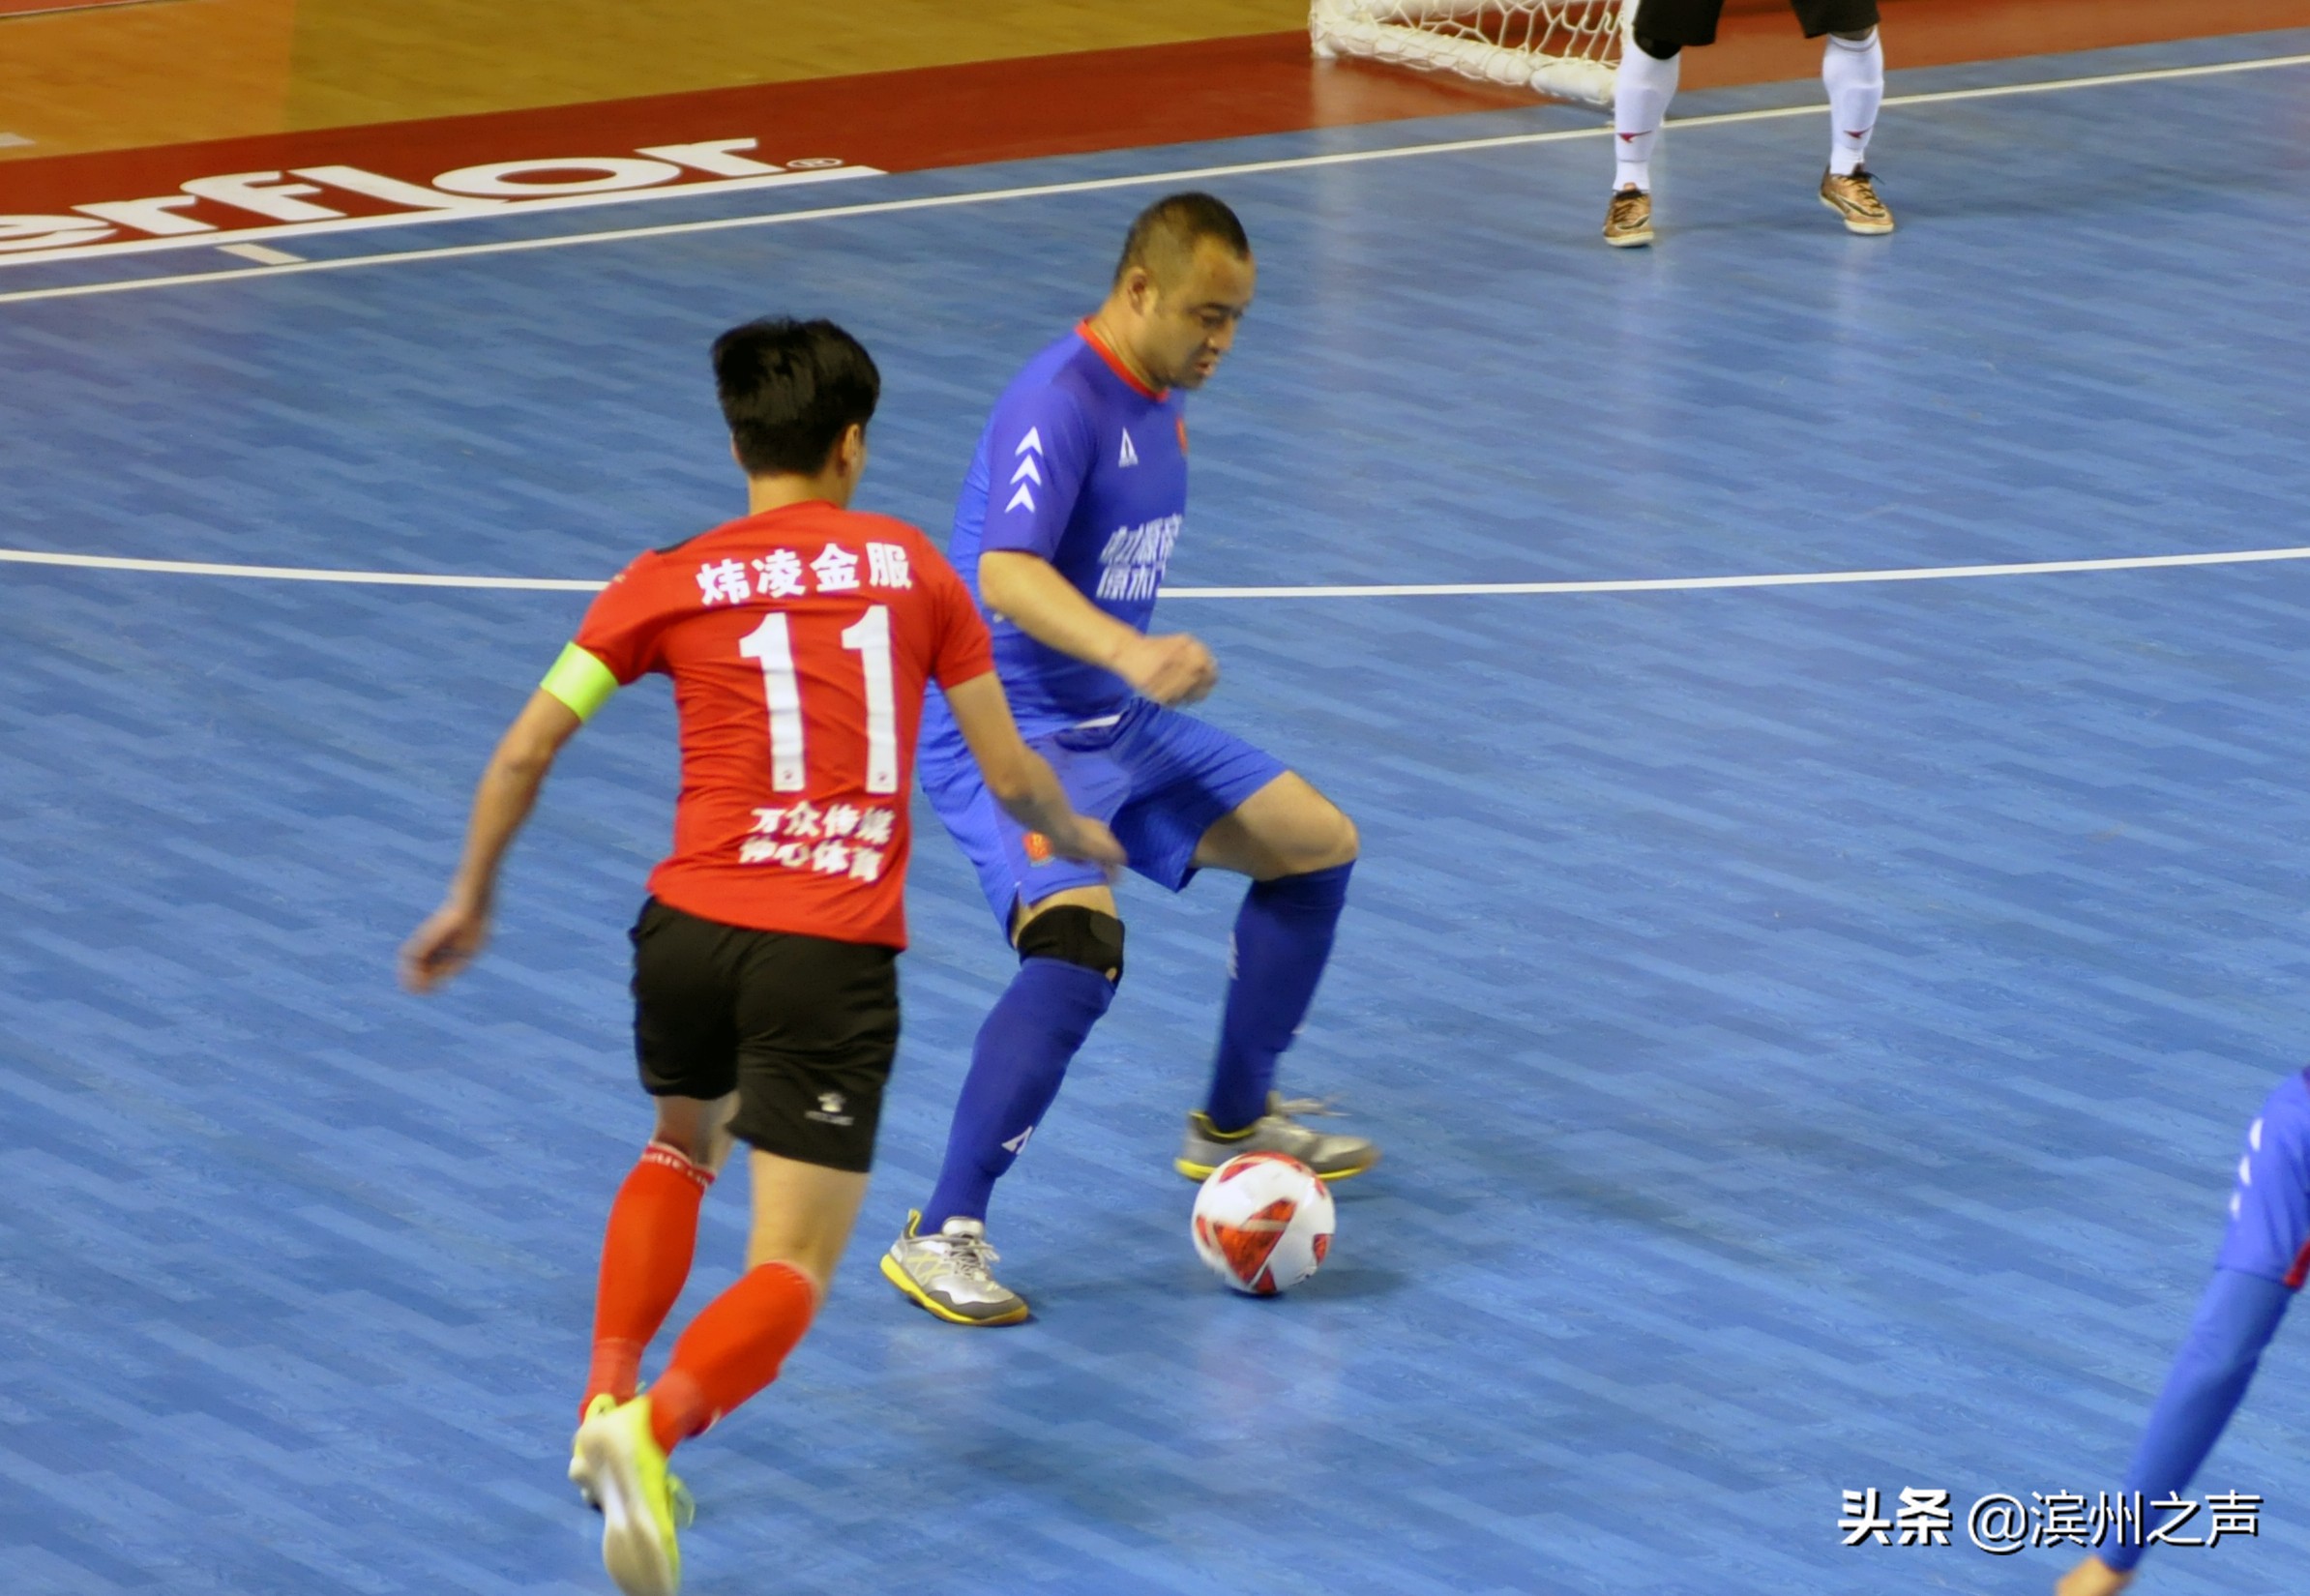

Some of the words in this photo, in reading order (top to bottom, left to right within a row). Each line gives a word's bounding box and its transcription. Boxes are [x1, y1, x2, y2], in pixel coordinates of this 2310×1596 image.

[695, 542, 913, 606] 炜凌金服
[738, 605, 899, 794] 11
